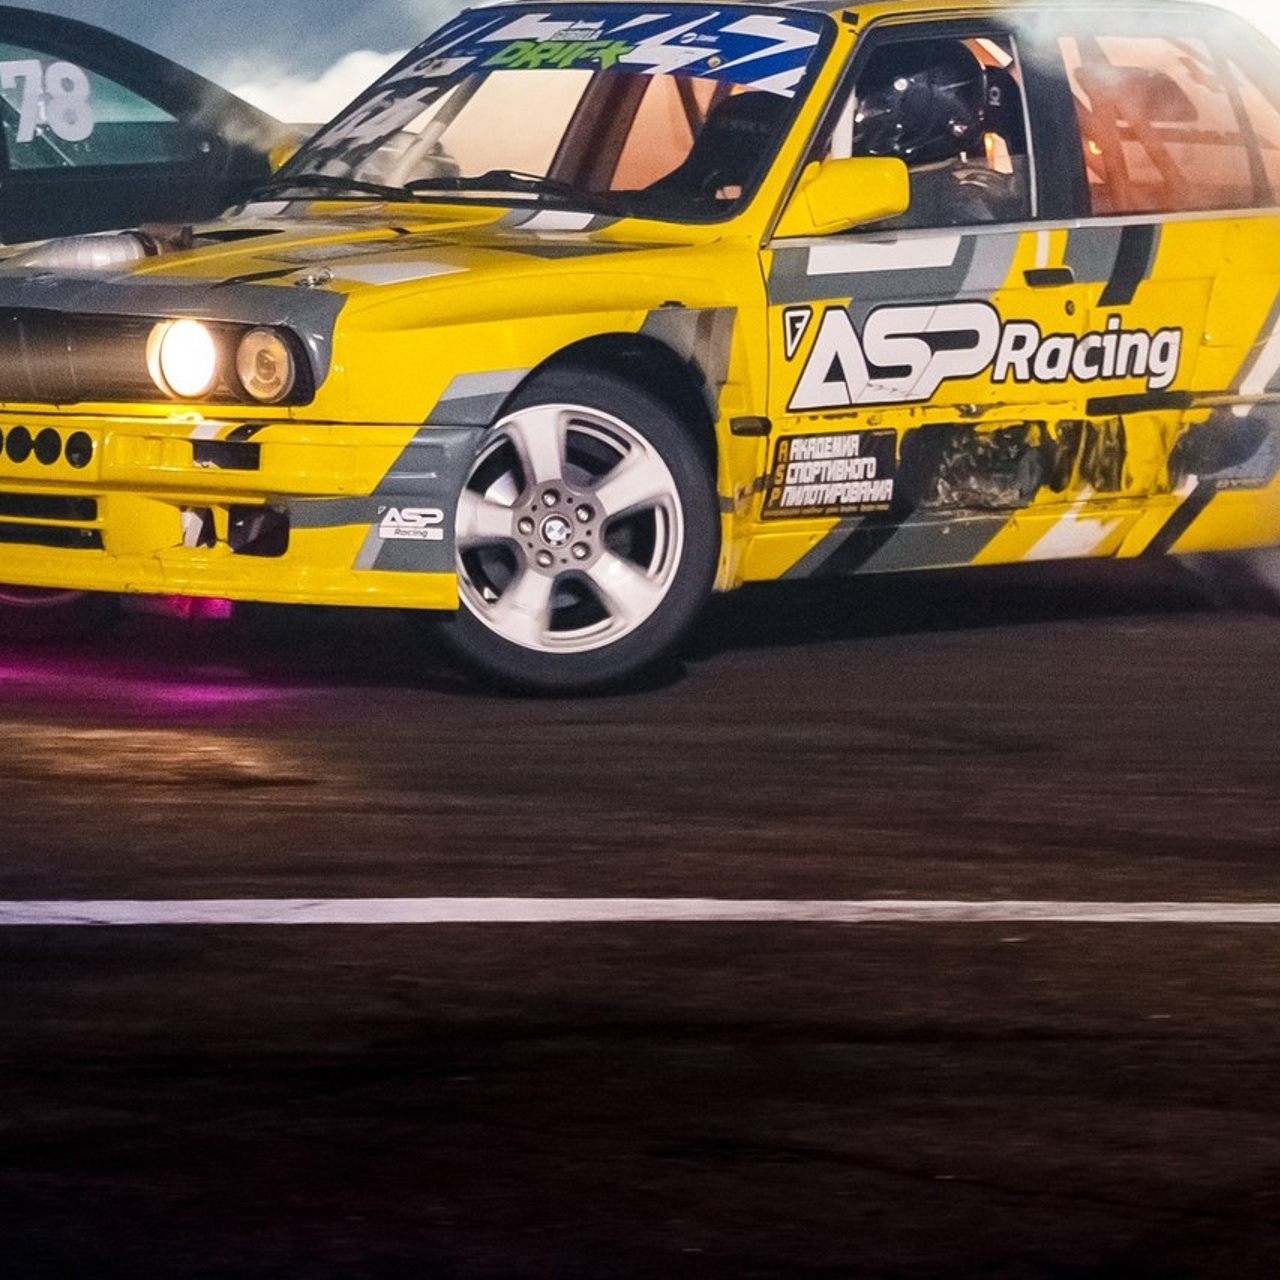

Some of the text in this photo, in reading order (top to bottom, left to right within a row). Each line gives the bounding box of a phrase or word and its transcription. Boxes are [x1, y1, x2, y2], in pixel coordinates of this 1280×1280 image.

[480, 40, 635, 70] DRIFT
[787, 302, 1182, 411] ASP Racing
[789, 434, 861, 461] АКАДЕМИЯ
[785, 456, 877, 484] СПОРТИВНОГО
[780, 479, 894, 507] ПИЛОТИРОВАНИЯ
[380, 507, 445, 528] ASP
[394, 529, 428, 538] Racing
